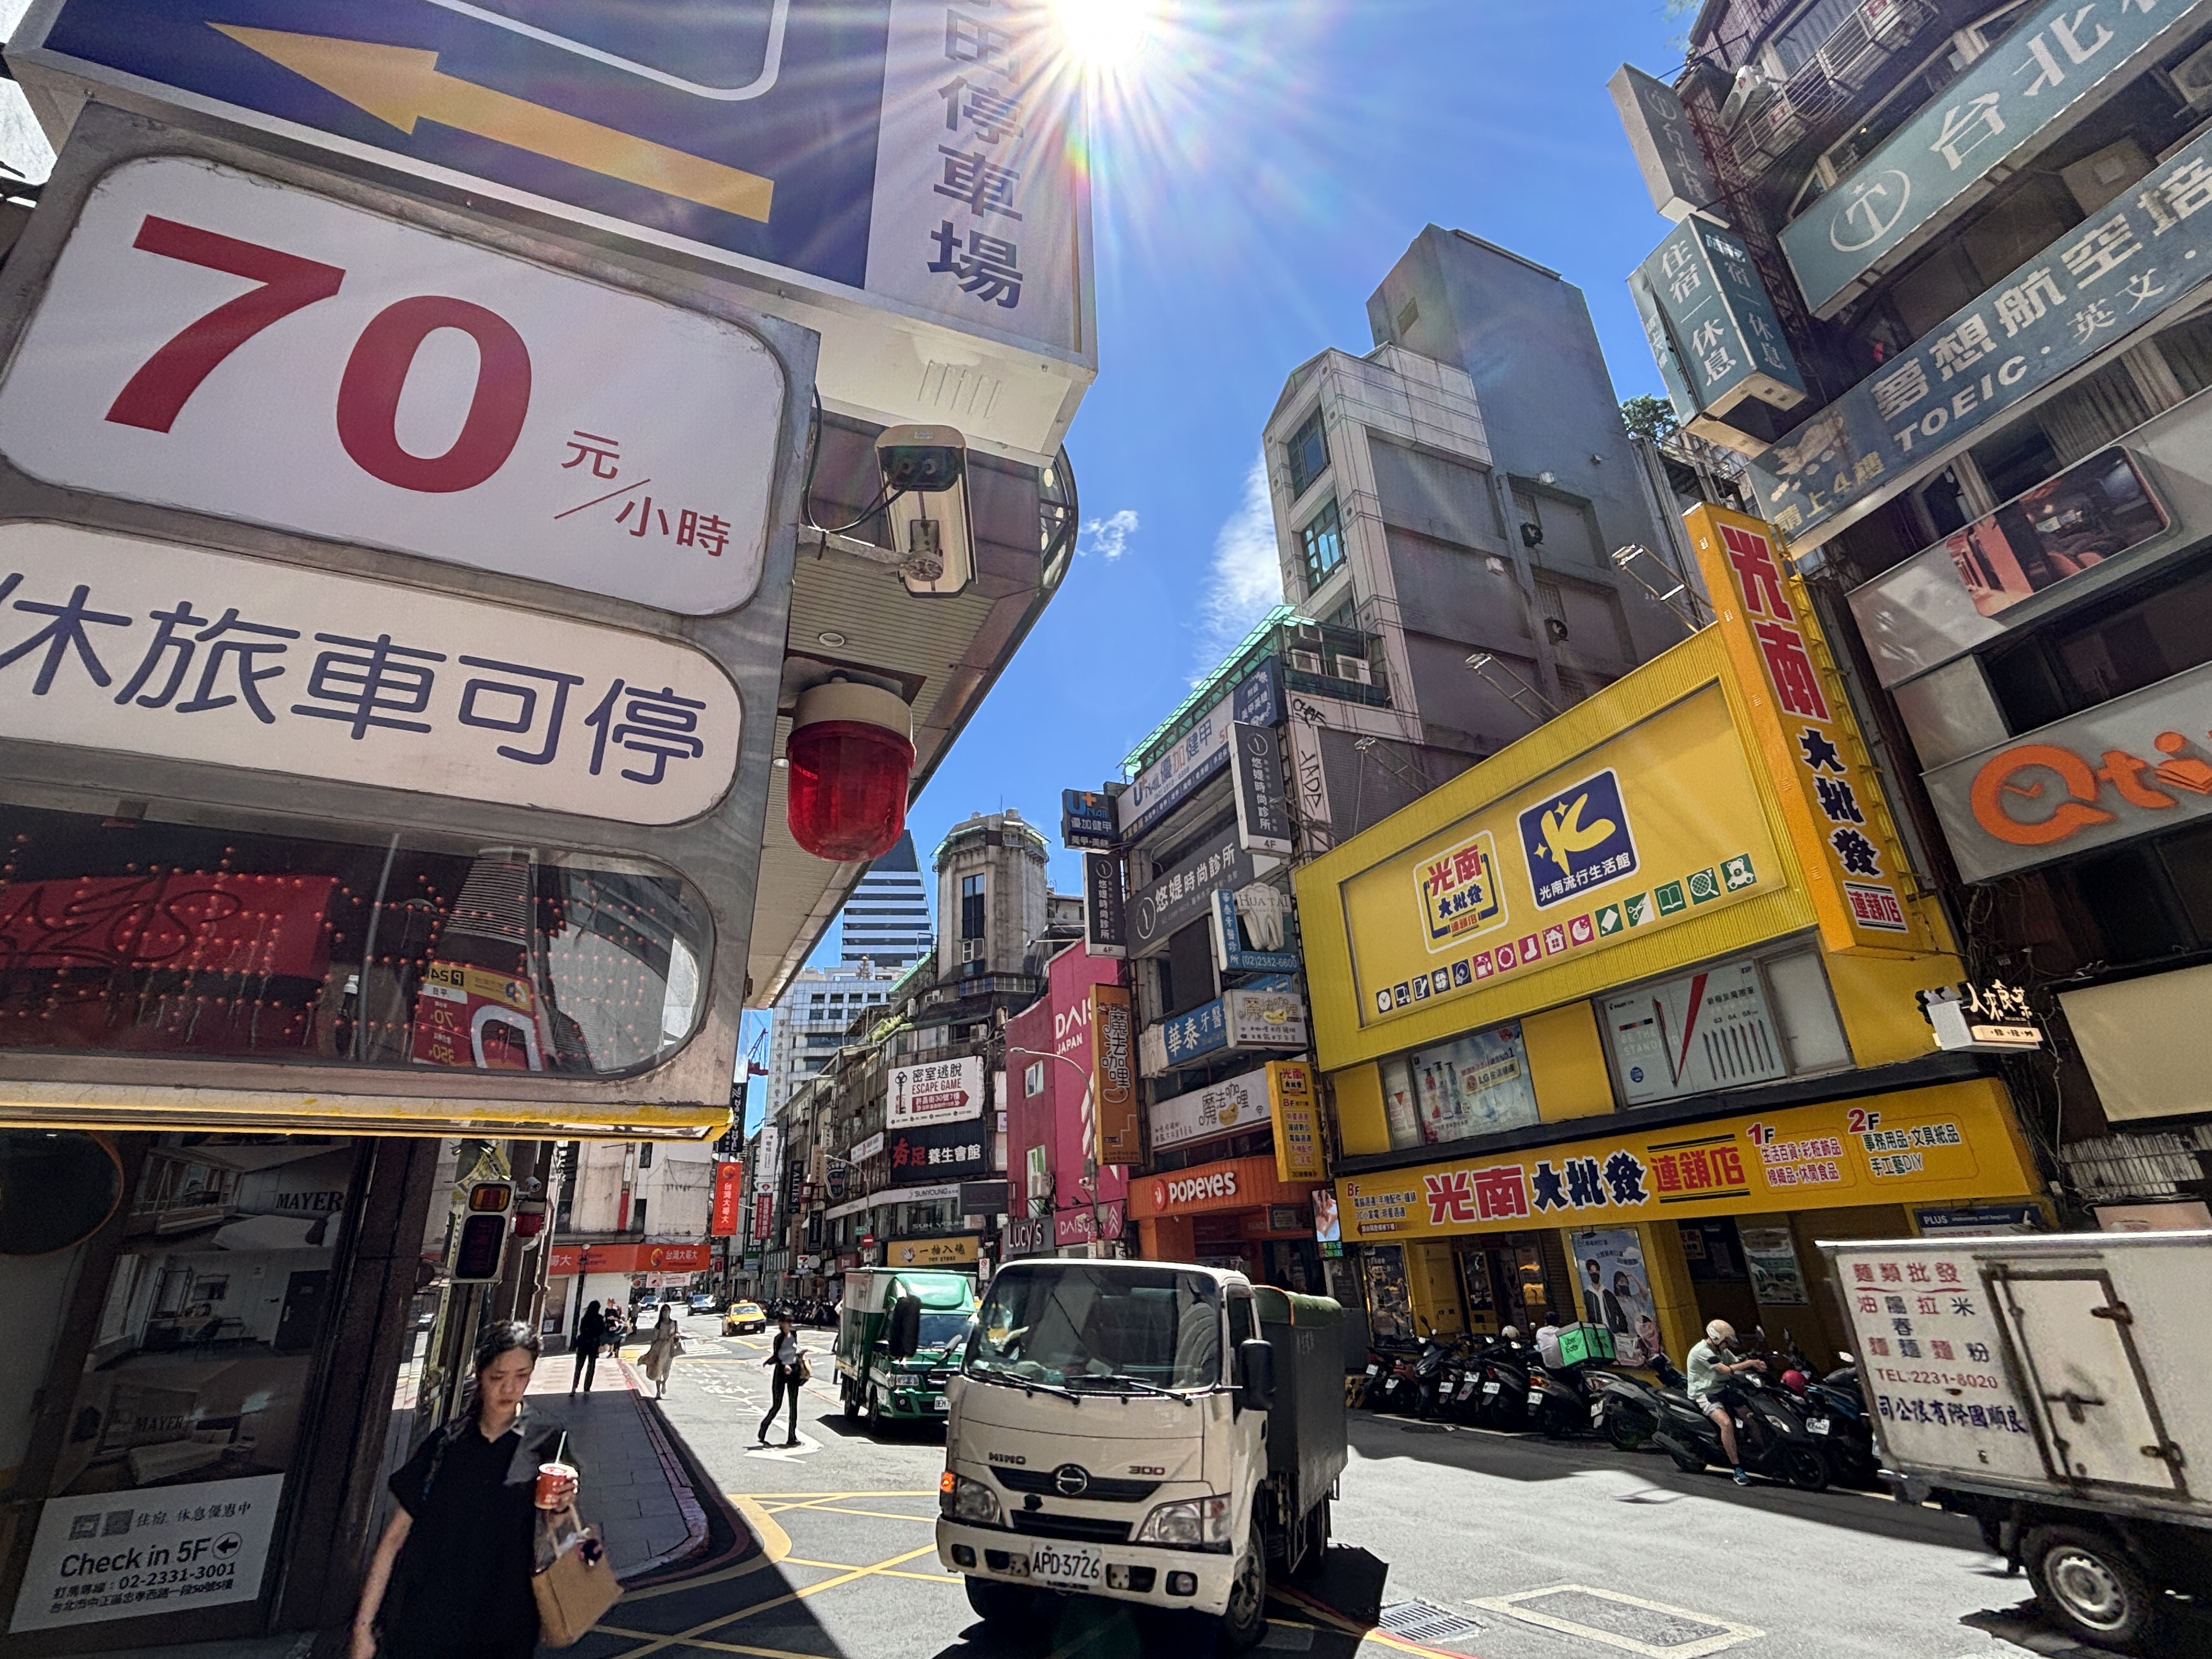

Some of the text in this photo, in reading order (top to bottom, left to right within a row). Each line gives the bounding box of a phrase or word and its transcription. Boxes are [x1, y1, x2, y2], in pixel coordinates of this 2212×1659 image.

[1930, 0, 2159, 171] 台北
[1661, 239, 1737, 387] 住宿 休息
[2068, 268, 2166, 346] 英文
[104, 214, 532, 493] 70
[1894, 356, 2028, 452] TOEIC
[1971, 730, 2212, 846] Qti
[1427, 844, 1482, 898] 光南
[1538, 851, 1632, 902] 光南流行生活館
[1056, 1032, 1083, 1056] JAPAN
[1101, 1008, 1131, 1088] 魔法咖哩
[1167, 1004, 1227, 1058] 華泰牙醫
[1624, 1035, 1679, 1056] STANDD
[912, 1062, 962, 1084] 密室逃脫
[912, 1077, 962, 1094] ESCAPE GAME
[1747, 1108, 1881, 1146] 1F 2F
[278, 1191, 345, 1211] MAYER
[936, 1220, 964, 1228] YOUN
[1923, 1215, 1948, 1224] PLUS
[665, 1249, 698, 1261] 台灣大哥大
[989, 1451, 1026, 1465] HINO
[1128, 1465, 1165, 1476] 300
[60, 1536, 212, 1577] Check in 5F
[1032, 1548, 1099, 1581] APD-3726
[119, 1561, 236, 1589] 02-2331-3001
